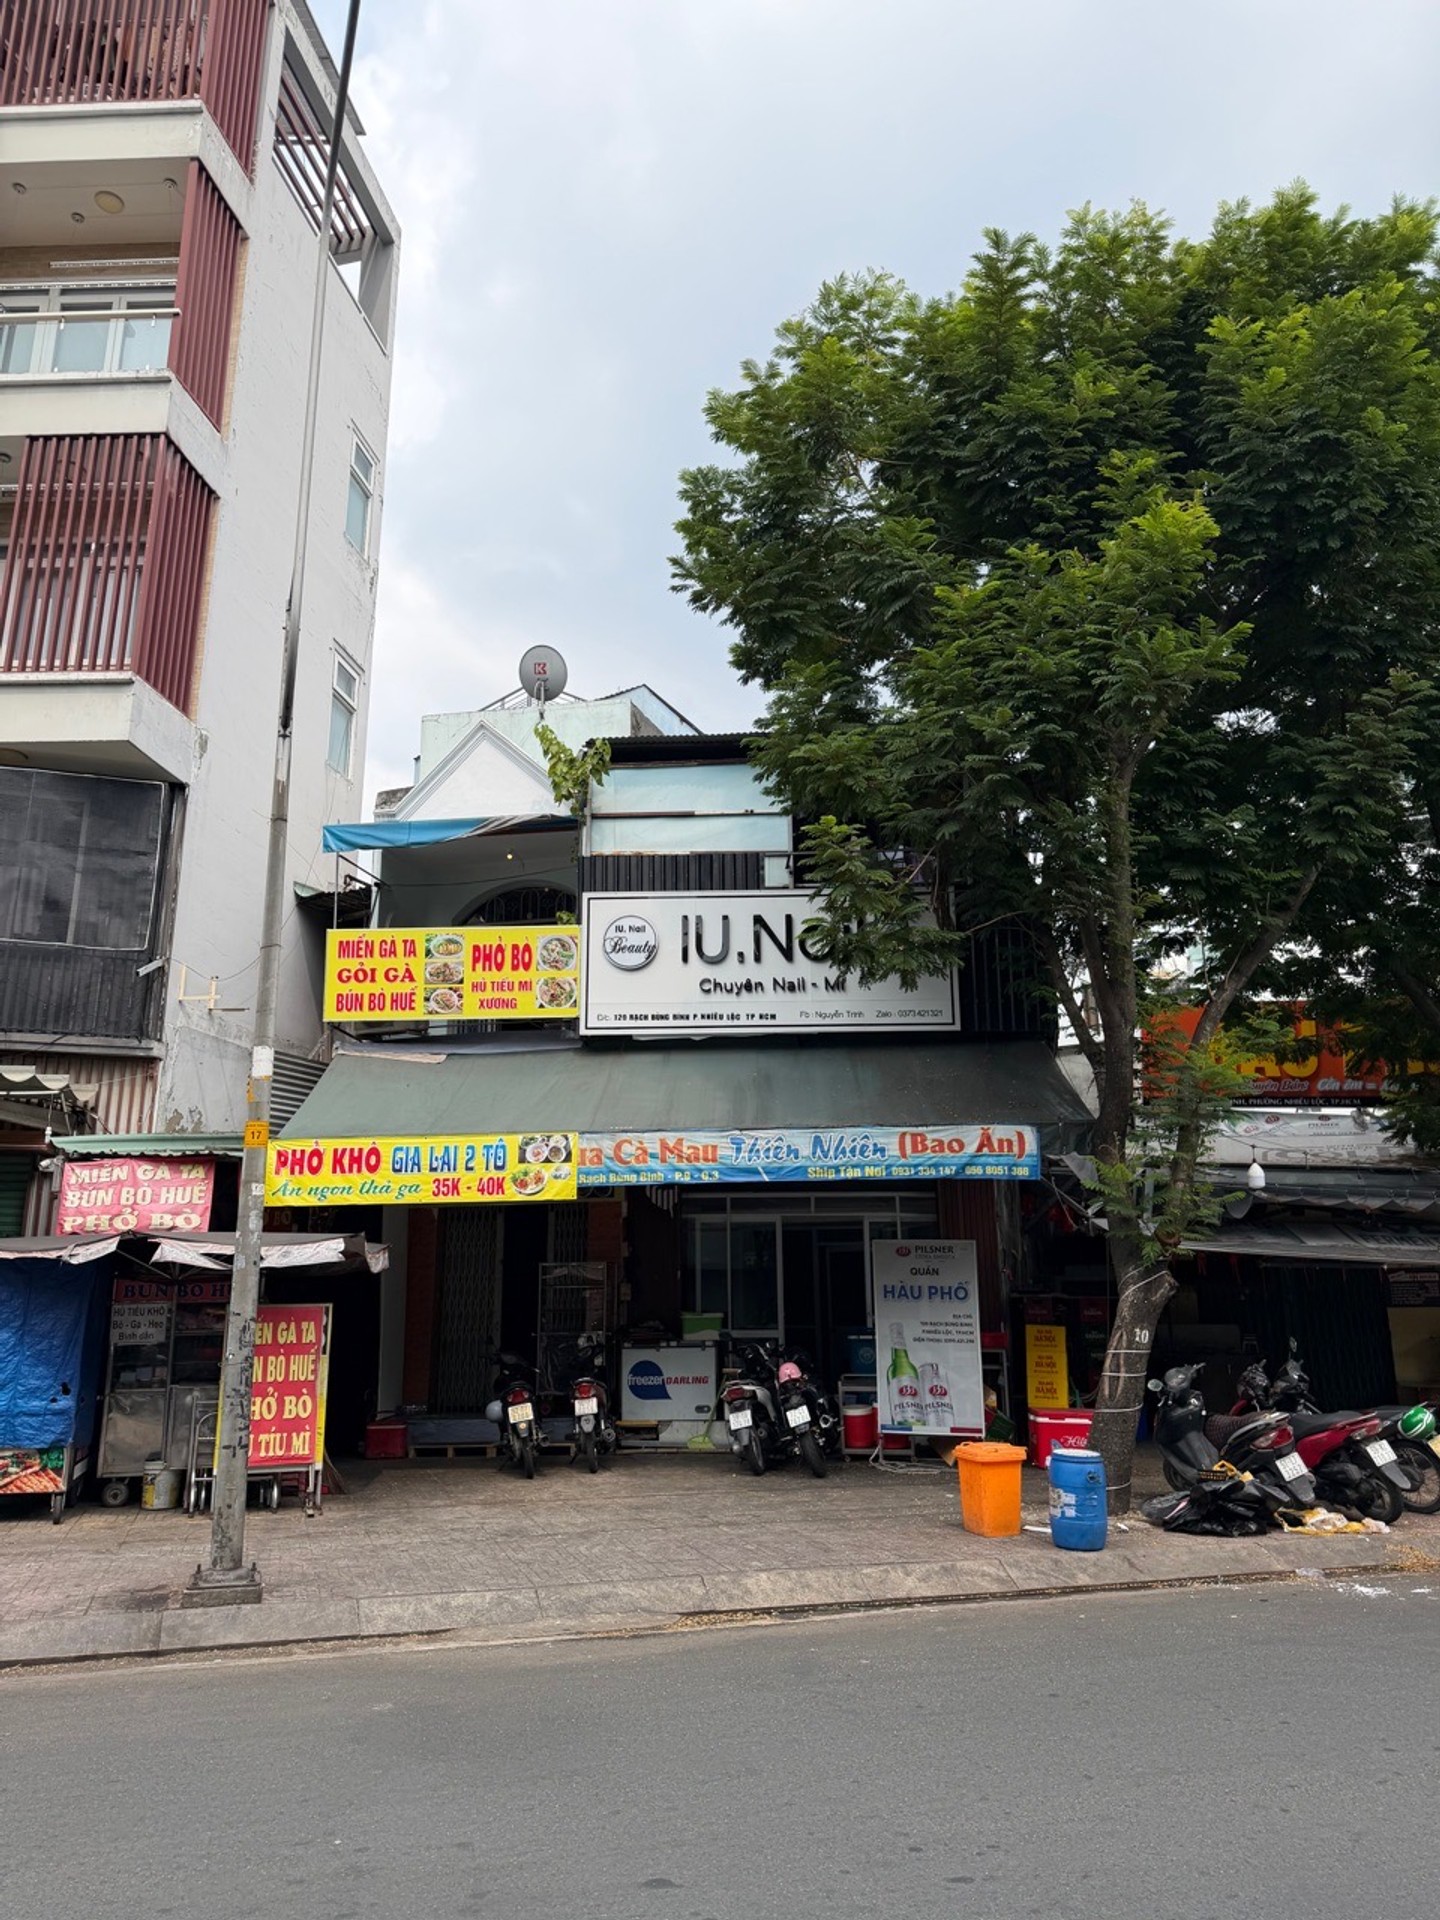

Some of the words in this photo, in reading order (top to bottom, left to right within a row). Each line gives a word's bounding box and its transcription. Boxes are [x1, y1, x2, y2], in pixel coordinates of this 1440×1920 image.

[337, 934, 372, 959] MIẾN
[379, 935, 396, 959] GÀ
[402, 939, 417, 957] TA
[471, 936, 507, 972] PHỞ
[510, 936, 533, 971] BÒ
[605, 936, 657, 960] Beauty
[337, 962, 377, 983] GỎI
[384, 963, 416, 983] GÀ
[336, 988, 364, 1012] BÚN
[368, 988, 386, 1011] BÒ
[390, 986, 419, 1011] HUẾ
[699, 978, 764, 996] Chuyên
[773, 977, 806, 992] Nail
[251, 1130, 262, 1140] 17
[613, 1138, 650, 1166] Cà
[658, 1137, 719, 1164] Mau
[729, 1134, 801, 1165] Thiên
[811, 1132, 888, 1163] Nhiên
[897, 1131, 966, 1161] (Bao
[974, 1126, 1026, 1161] Ăn)
[274, 1140, 325, 1176] PHỞ
[331, 1141, 382, 1175] KHÔ
[391, 1144, 422, 1174] GIA
[428, 1144, 458, 1174] LAI
[464, 1144, 476, 1172] 2
[482, 1138, 508, 1172] TÔ
[69, 1162, 130, 1185] MIẾN
[136, 1162, 171, 1181] GÀ
[180, 1164, 207, 1180] TA
[807, 1167, 835, 1180] Ship
[64, 1185, 114, 1208] BÚN
[119, 1184, 153, 1206] BÒ
[159, 1179, 209, 1205] HUẾ
[307, 1184, 353, 1202] ngon
[395, 1183, 422, 1200] ga
[431, 1178, 461, 1198] 35K
[476, 1176, 506, 1196] 40K
[61, 1208, 140, 1233] PHỞ
[150, 1210, 202, 1231] BÒ
[915, 1245, 954, 1254] PILSNER
[910, 1265, 940, 1276] QUÁN
[883, 1281, 922, 1300] HÀU
[928, 1281, 969, 1301] PHỐ
[277, 1317, 297, 1344] GÀ
[302, 1321, 316, 1344] TA
[267, 1349, 286, 1383] BÒ
[289, 1346, 319, 1381] HUẾ
[628, 1374, 663, 1386] freezer
[666, 1375, 709, 1385] DARLING
[283, 1388, 313, 1419] BÒ
[259, 1427, 287, 1457] TÍU
[291, 1425, 312, 1456] MÌ
